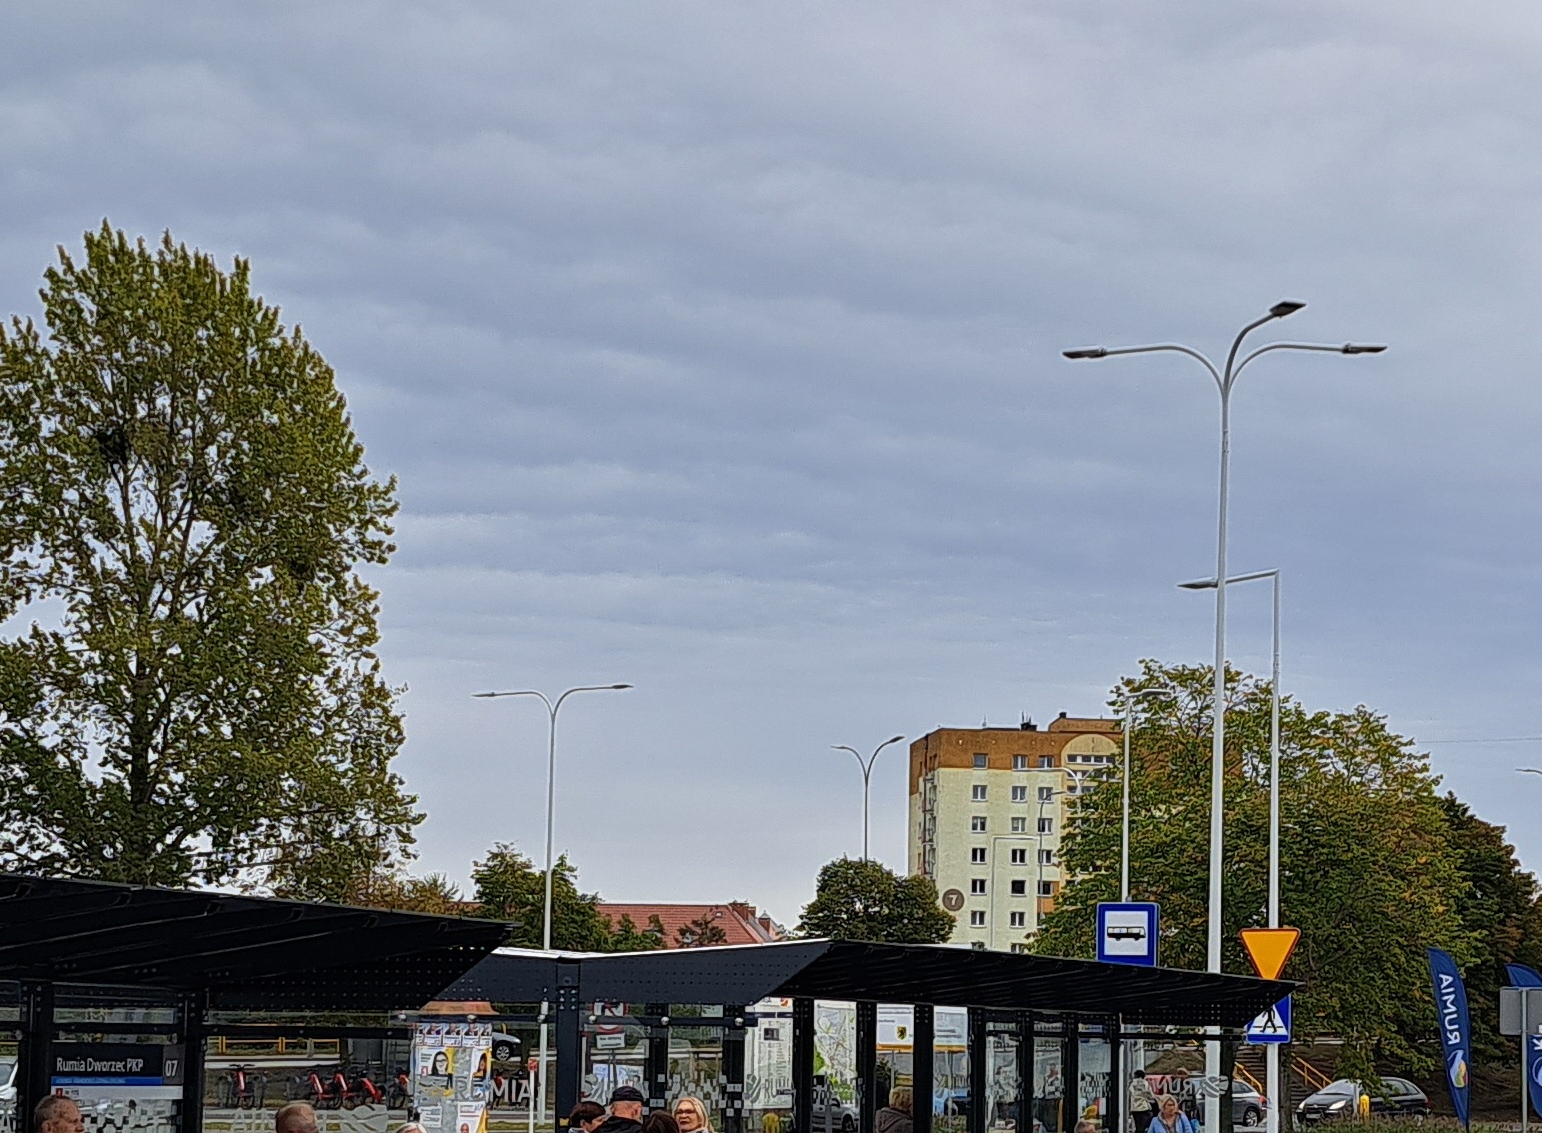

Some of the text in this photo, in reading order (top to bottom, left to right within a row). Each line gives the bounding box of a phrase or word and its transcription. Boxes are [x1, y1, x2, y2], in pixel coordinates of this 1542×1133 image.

[947, 894, 959, 906] 7
[56, 1056, 178, 1078] Rumia Dworzec PKP 07
